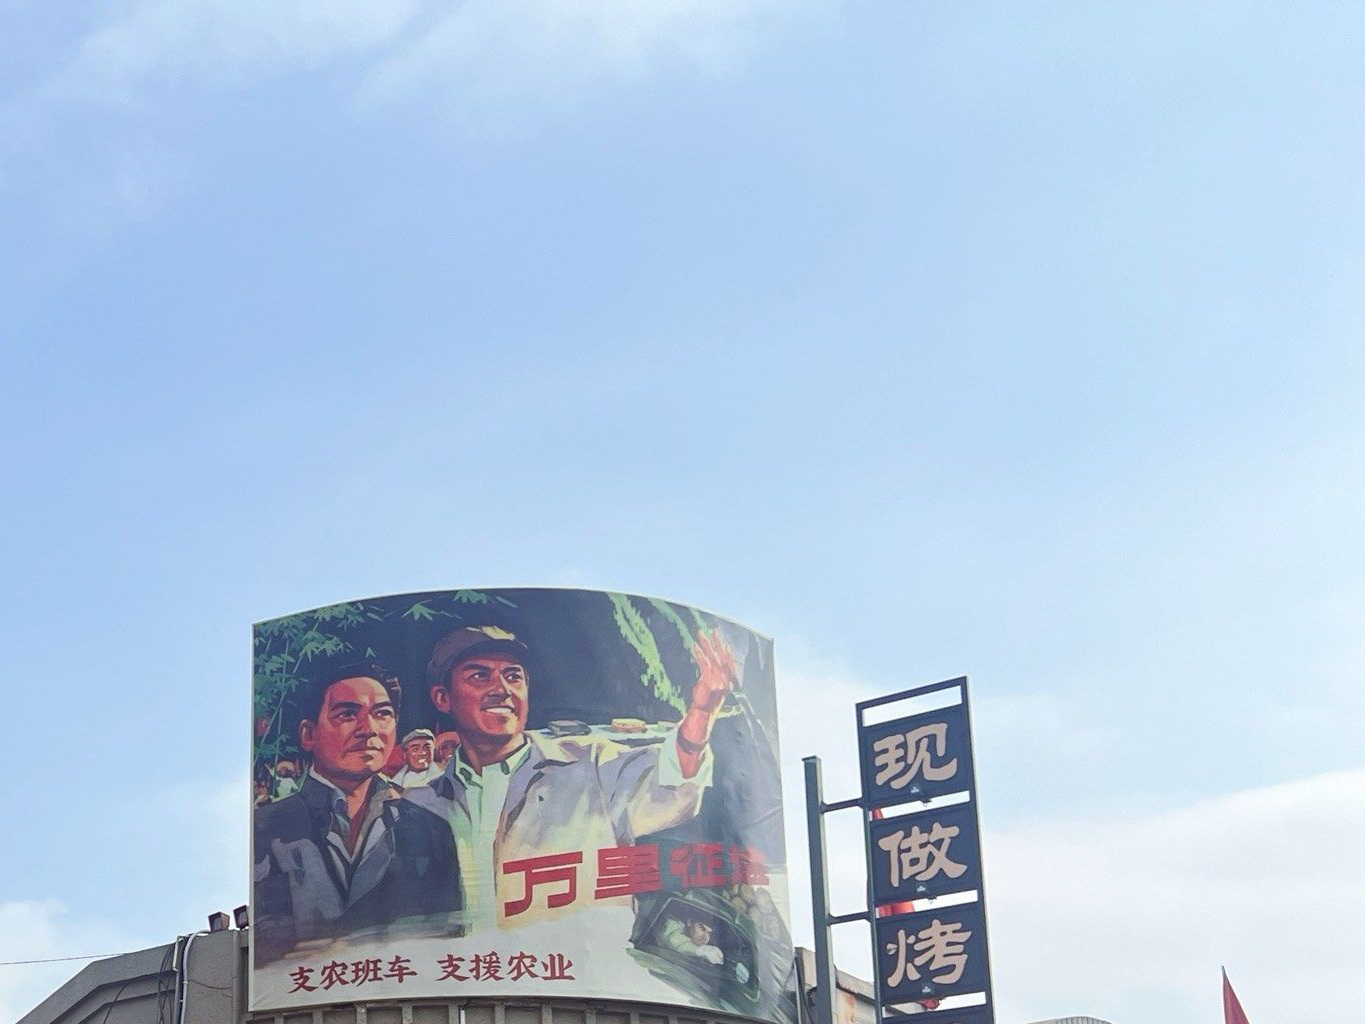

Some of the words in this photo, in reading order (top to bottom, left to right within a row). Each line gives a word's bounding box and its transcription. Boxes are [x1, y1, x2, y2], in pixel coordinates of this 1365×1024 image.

[287, 954, 417, 993] 支农班车
[436, 950, 575, 983] 支援农业
